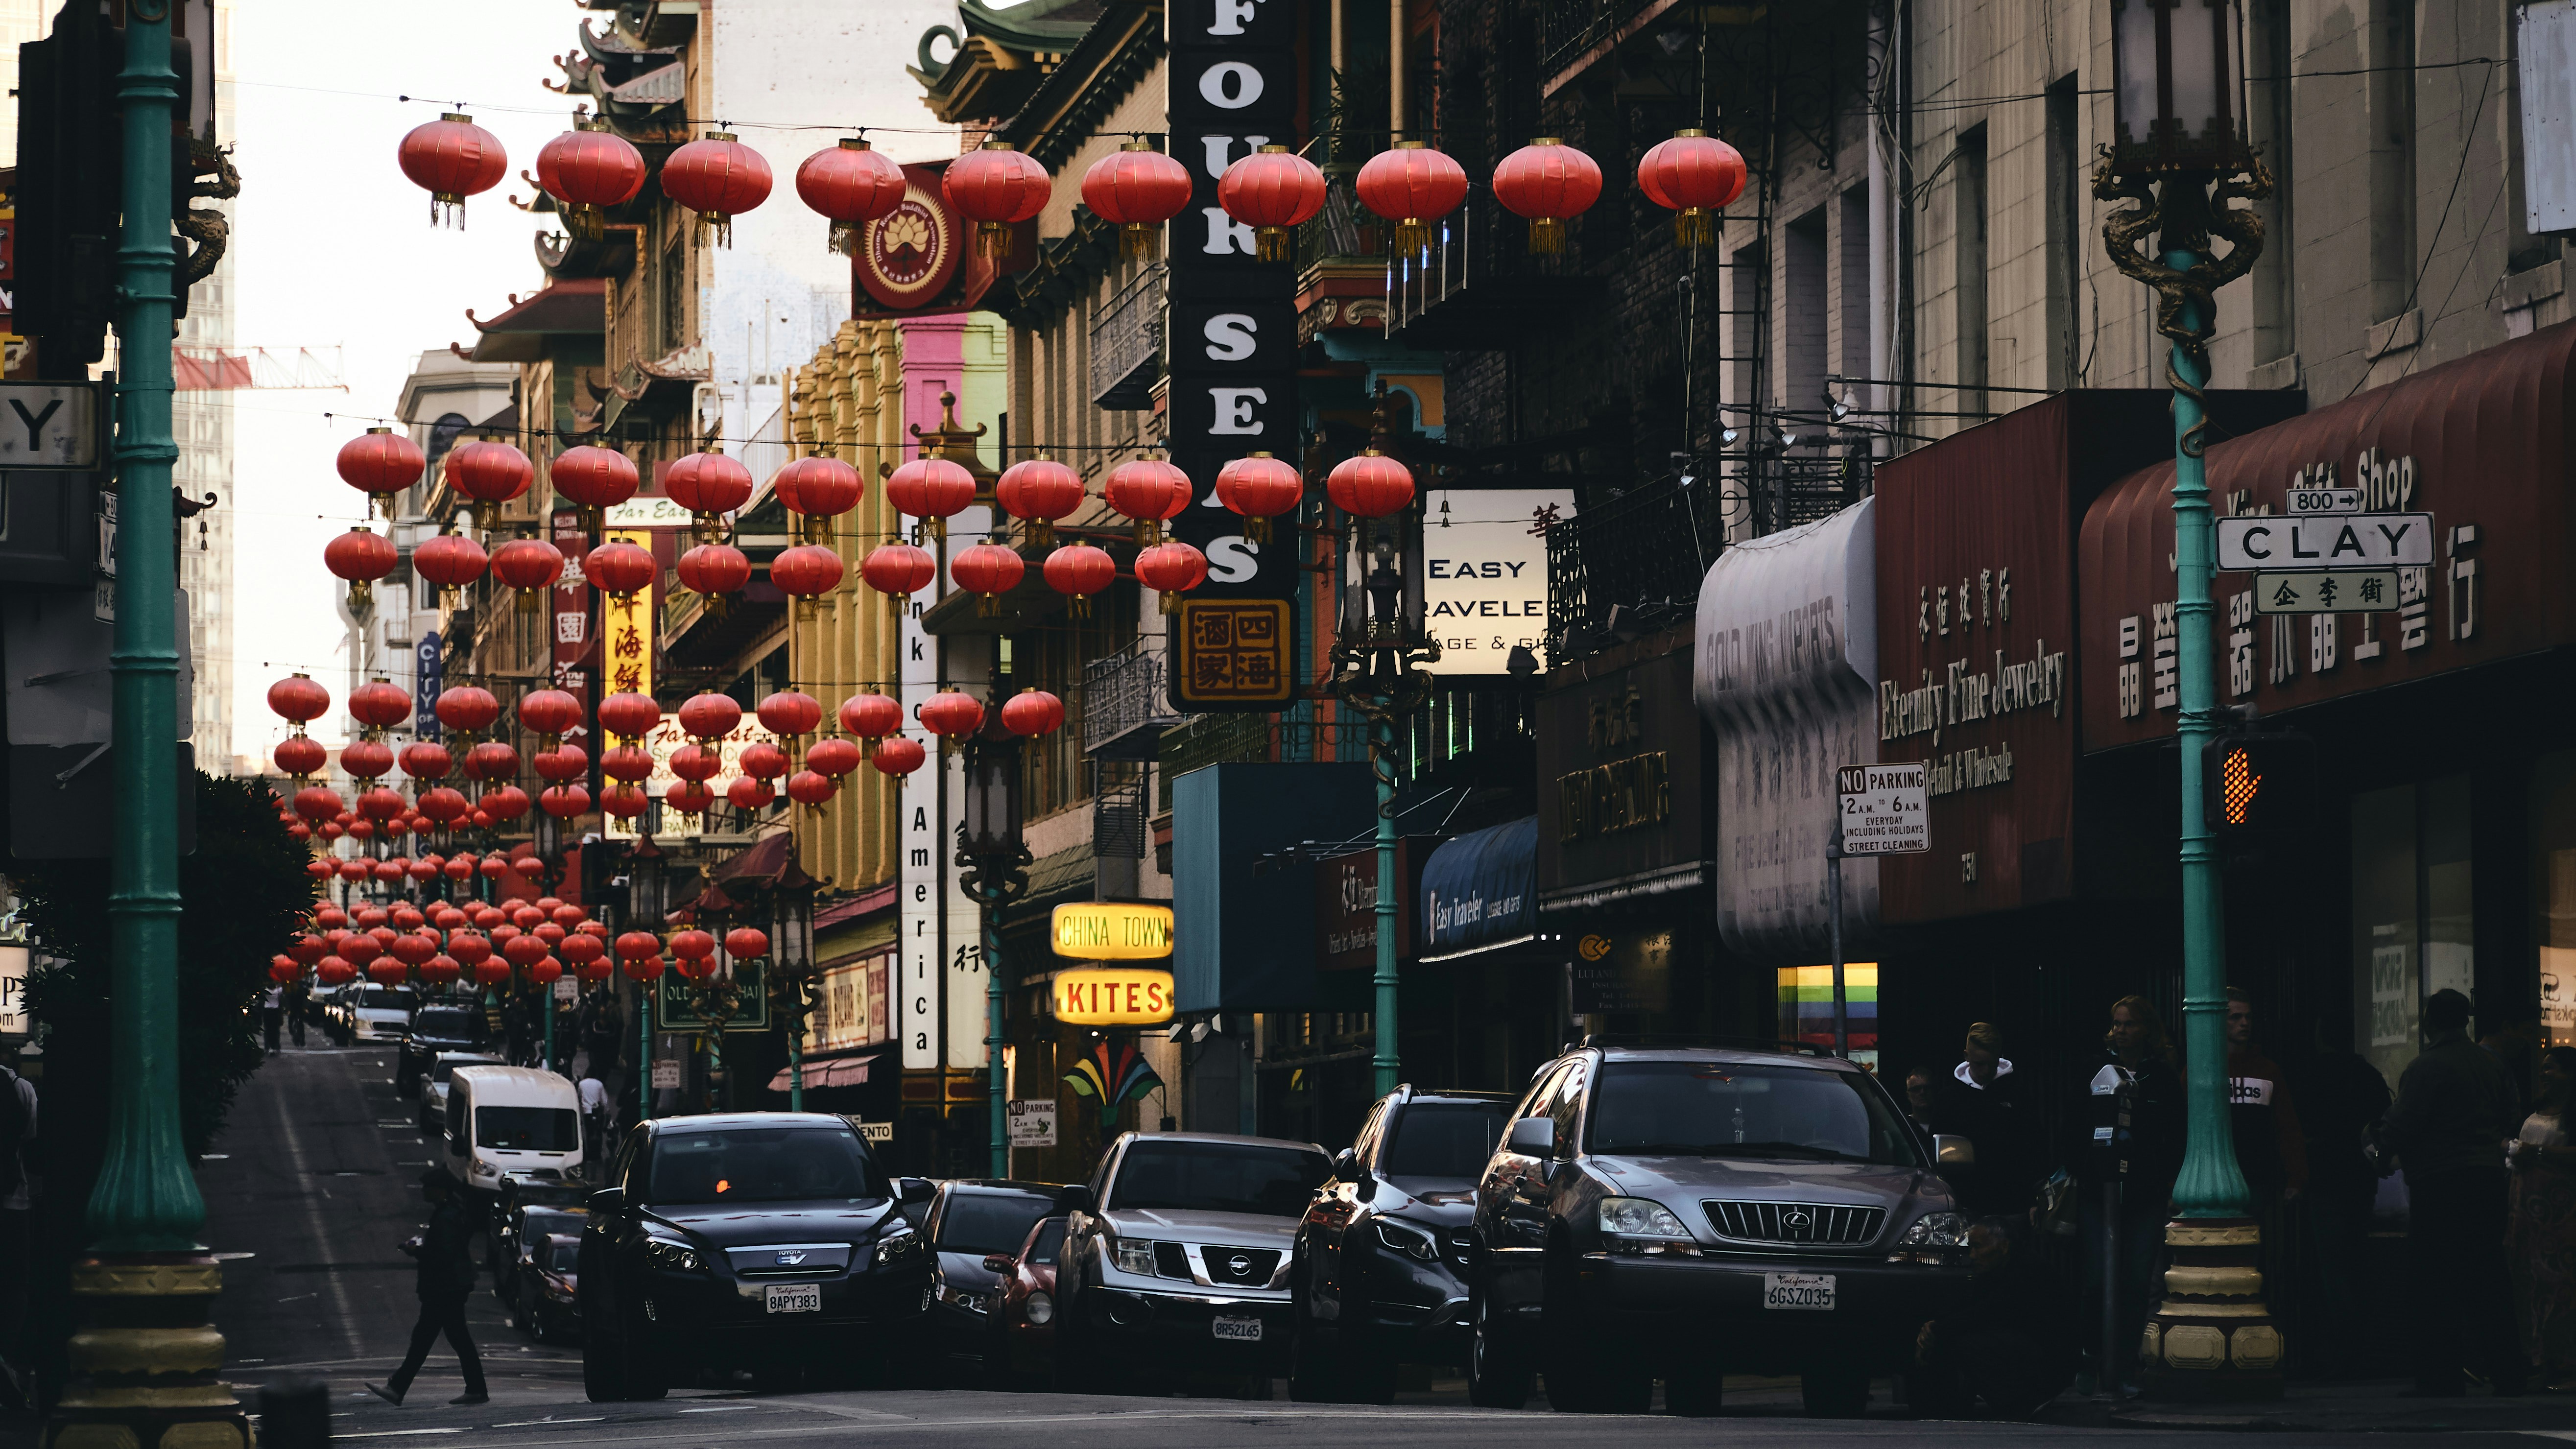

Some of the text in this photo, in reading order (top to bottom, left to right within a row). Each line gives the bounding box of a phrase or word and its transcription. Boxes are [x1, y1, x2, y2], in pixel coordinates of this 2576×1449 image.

[901, 203, 929, 219] Buddhist
[927, 221, 937, 264] Association
[8, 400, 63, 451] Y
[1201, 313, 1267, 584] SES
[2357, 447, 2413, 513] Shop
[614, 500, 693, 521] Far Eas
[2297, 493, 2333, 510] 800
[2242, 524, 2410, 560] CLAY
[1429, 559, 1527, 578] EASY
[2273, 577, 2384, 608] 企李街
[1424, 601, 1543, 617] AVELE
[1491, 636, 1506, 649] &
[1880, 639, 2065, 747] Eternity Fine Jewelry
[1923, 741, 2013, 797] Retail & Wholesale
[1841, 770, 1923, 792] NO PARKING
[1846, 798, 1856, 814] 2
[1859, 805, 1875, 813] A.M.
[1893, 796, 1902, 812] 6
[1905, 803, 1922, 811] A.M.
[1866, 816, 1903, 826] EVERYDAY
[1846, 825, 1924, 837] INCLUDING HOLIDAYS
[1849, 839, 1923, 851] STREET CLEANING
[1436, 901, 1453, 937] Easy
[1454, 890, 1482, 926] Traveler
[911, 807, 928, 1050] America
[1063, 916, 1167, 947] CHINA TOWN
[2, 977, 16, 1006] P
[1068, 982, 1163, 1013] KITES
[1010, 1102, 1054, 1114] NO PARKING
[860, 1126, 890, 1137] ENTO
[1014, 1118, 1019, 1127] 2
[1779, 1275, 1823, 1287] California
[777, 1287, 810, 1295] California
[1768, 1287, 1831, 1305] 6GSZ035
[770, 1295, 817, 1309] 8APY383
[1216, 1323, 1259, 1337] 8R52165
